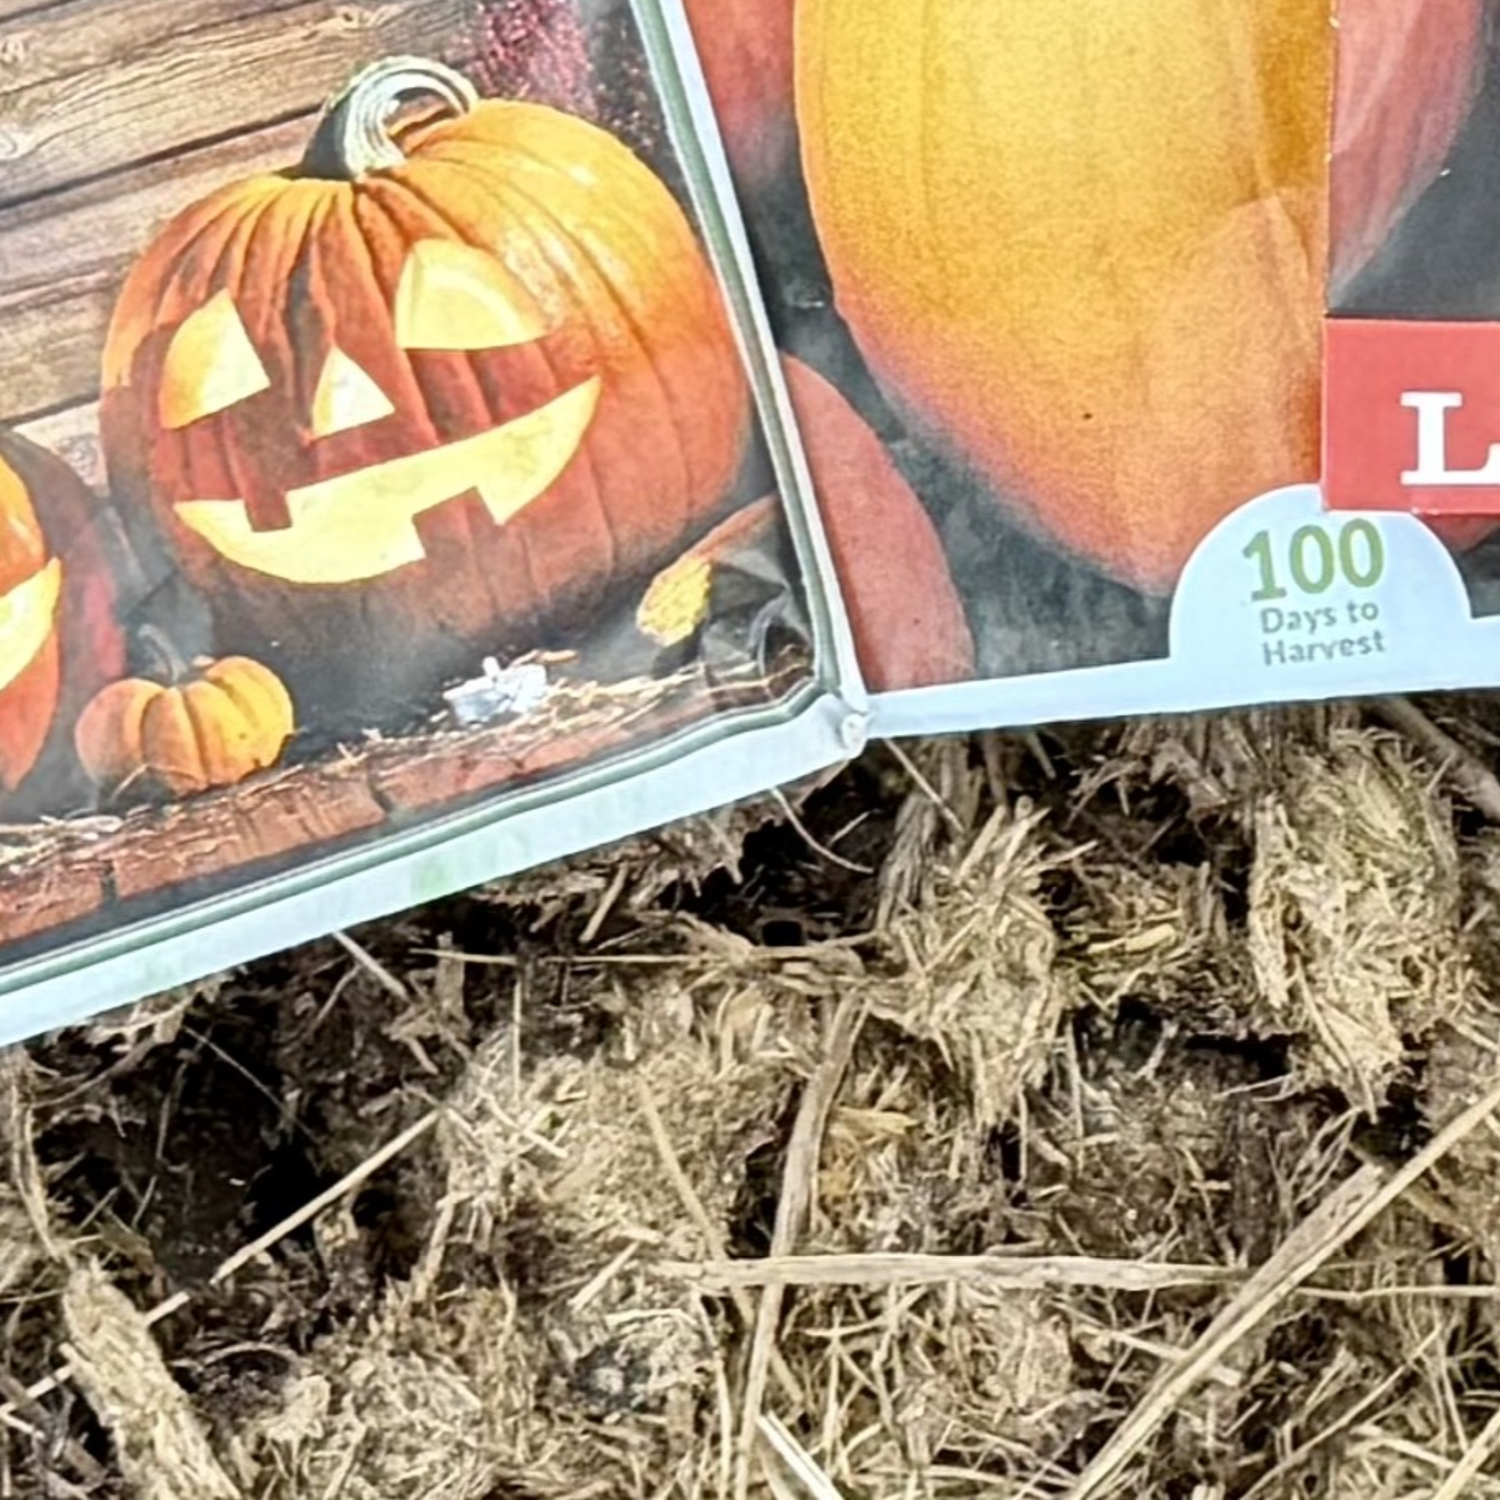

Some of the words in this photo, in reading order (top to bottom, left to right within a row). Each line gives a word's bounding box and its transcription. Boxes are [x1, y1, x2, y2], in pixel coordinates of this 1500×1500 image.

[1241, 517, 1385, 602] 100
[1259, 605, 1338, 635] Days
[1346, 601, 1380, 625] to
[1261, 629, 1387, 667] Harvest
